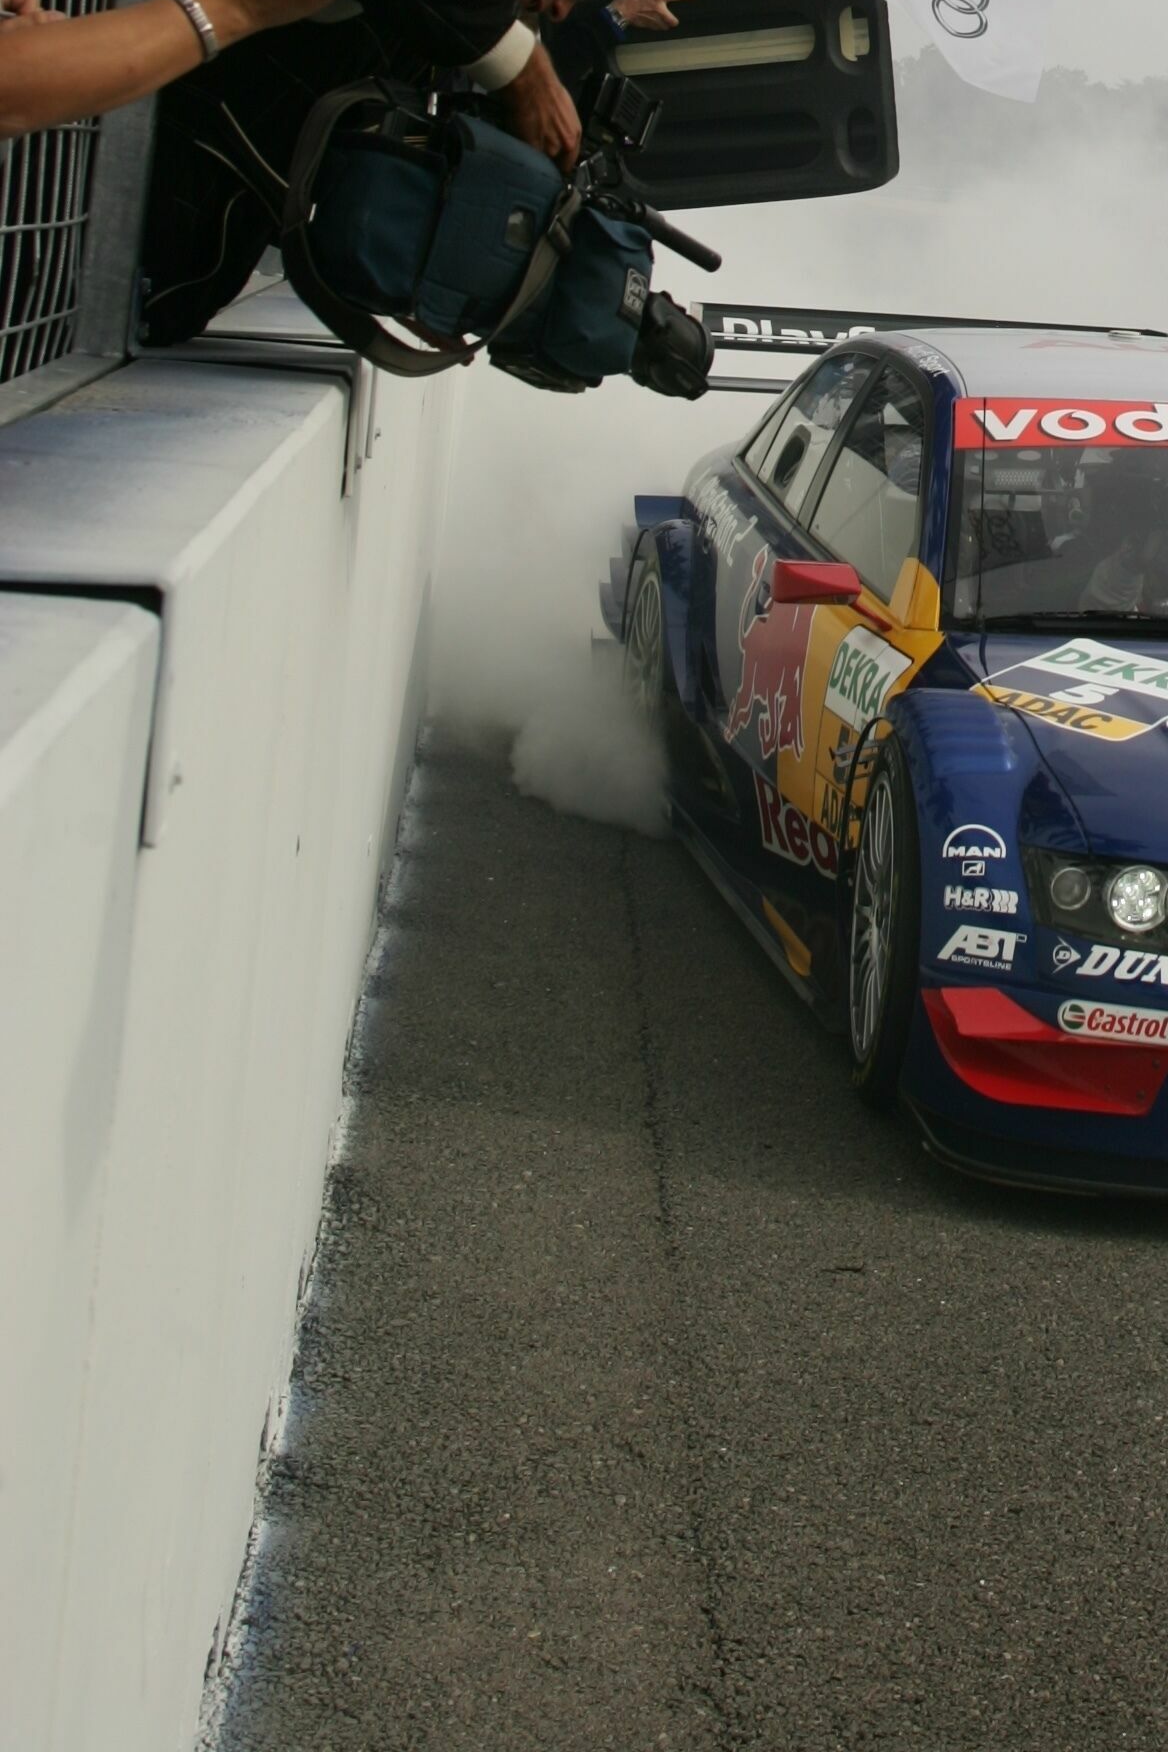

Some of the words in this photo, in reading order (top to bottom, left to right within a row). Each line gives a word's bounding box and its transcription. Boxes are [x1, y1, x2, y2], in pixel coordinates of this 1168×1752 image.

[829, 641, 891, 716] DEKRA
[1049, 682, 1119, 705] 5
[998, 692, 1113, 730] ADAC
[948, 846, 1000, 857] MAN
[937, 925, 1018, 960] ABT
